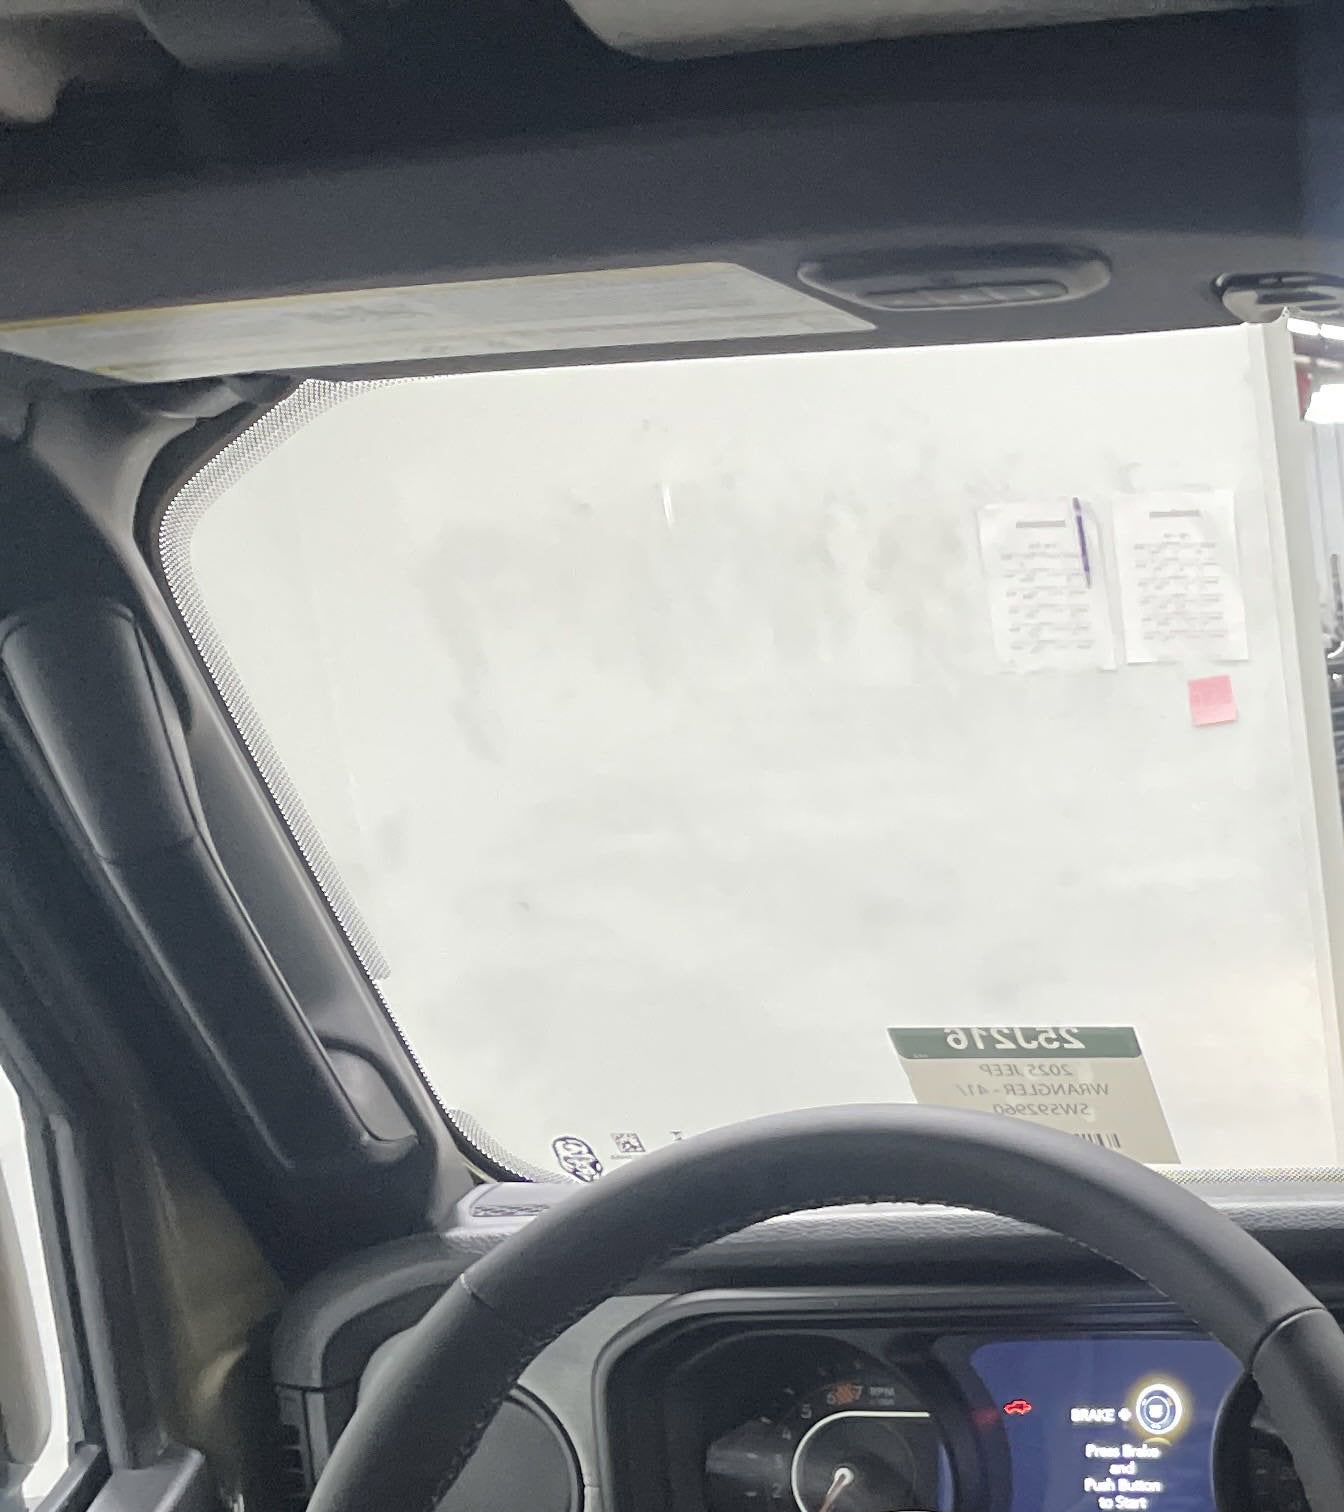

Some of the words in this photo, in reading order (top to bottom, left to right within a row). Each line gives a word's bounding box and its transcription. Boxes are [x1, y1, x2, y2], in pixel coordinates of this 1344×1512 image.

[800, 1403, 812, 1420] 5
[1070, 1407, 1116, 1422] BRAKE
[1085, 1443, 1120, 1459] Press
[1121, 1443, 1162, 1459] Brake
[1109, 1460, 1137, 1476] and
[1084, 1477, 1116, 1492] Push
[1117, 1478, 1164, 1492] Button
[1098, 1496, 1114, 1510] to
[1115, 1495, 1148, 1510] Start
